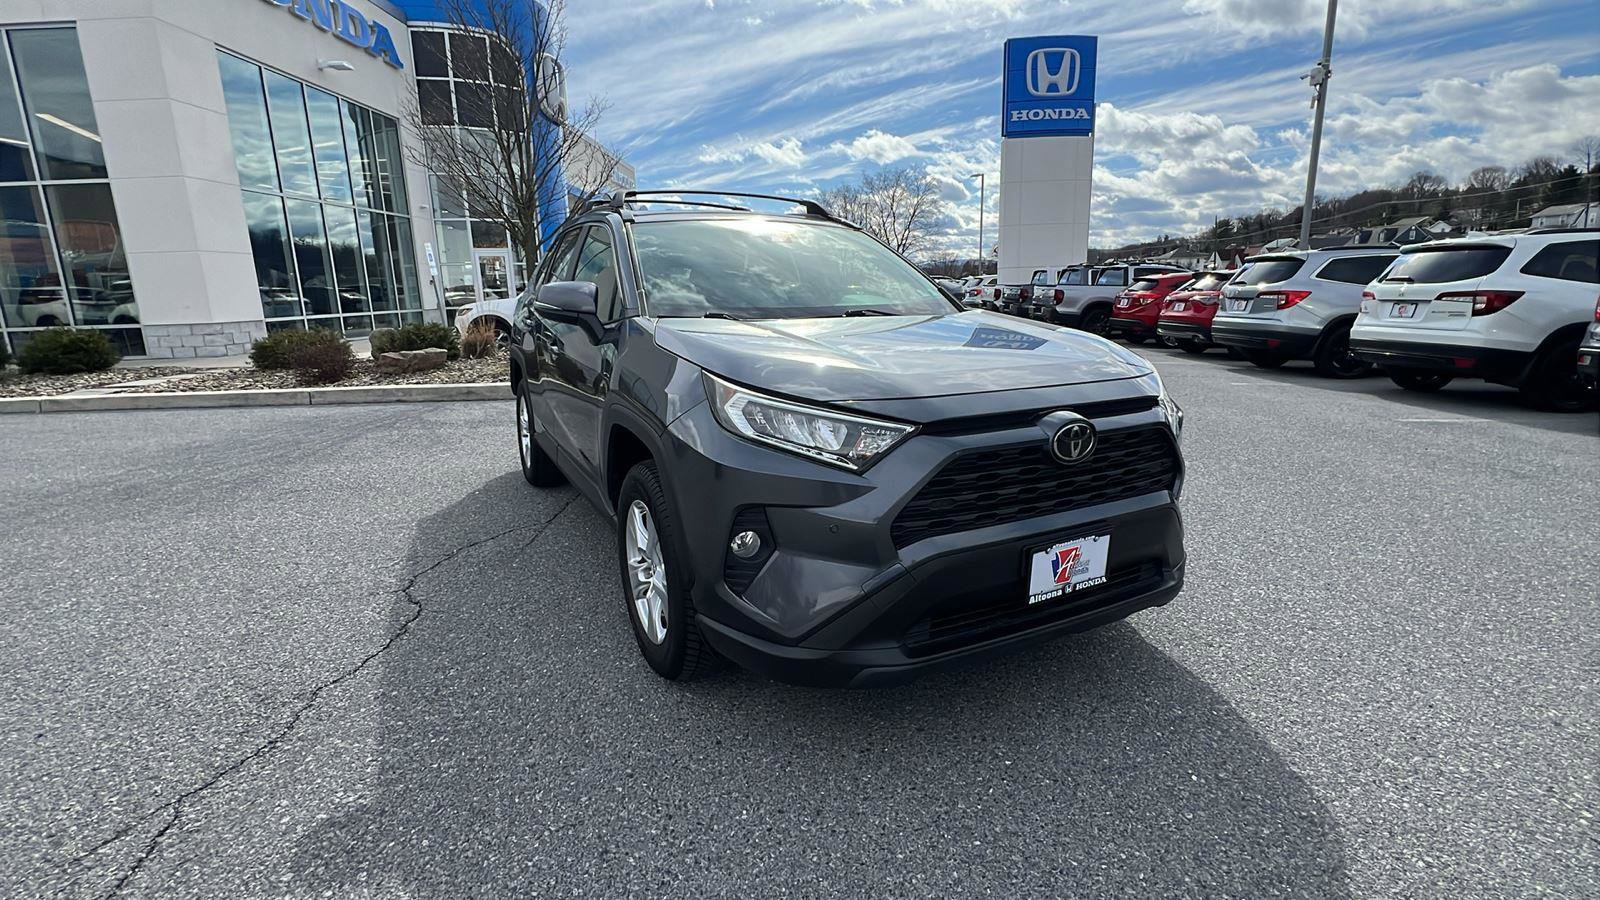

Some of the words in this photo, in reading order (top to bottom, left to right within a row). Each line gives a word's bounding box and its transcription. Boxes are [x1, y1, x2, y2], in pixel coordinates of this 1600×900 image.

[262, 0, 404, 69] NDA
[1010, 108, 1091, 121] HONDA
[1028, 589, 1062, 604] Altoona
[1076, 577, 1107, 591] HONDA
